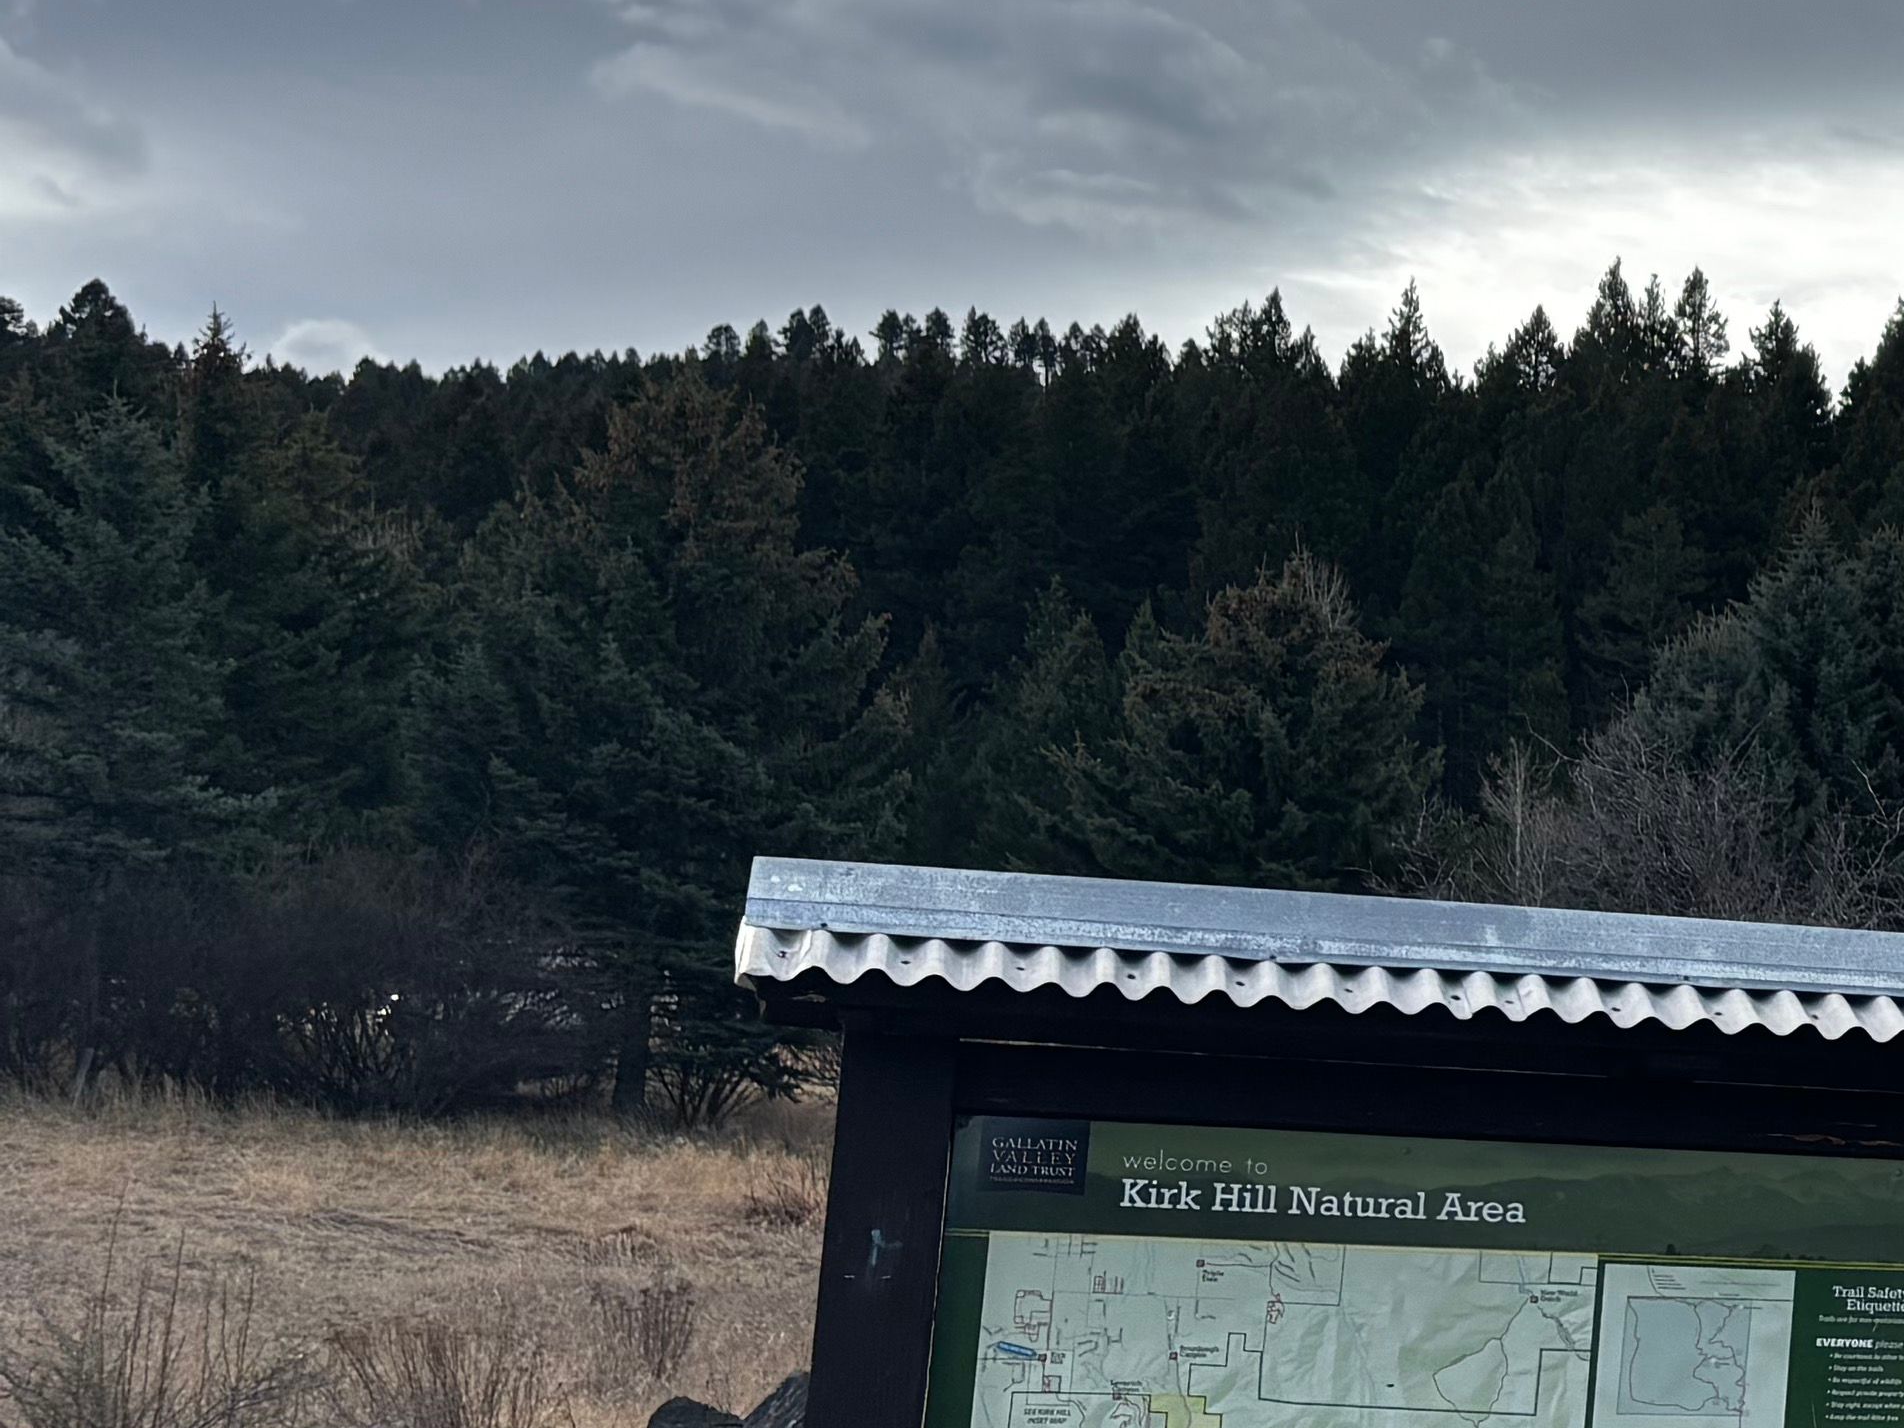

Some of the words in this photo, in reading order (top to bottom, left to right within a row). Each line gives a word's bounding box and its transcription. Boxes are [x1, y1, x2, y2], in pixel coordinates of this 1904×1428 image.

[992, 1137, 1077, 1151] GALLATIN
[992, 1150, 1075, 1164] VALLEY
[1123, 1150, 1232, 1173] welcome
[1247, 1158, 1267, 1175] to
[990, 1163, 1027, 1175] LAND
[1033, 1166, 1075, 1177] TRUST
[1120, 1179, 1201, 1210] Kirk
[1211, 1182, 1276, 1213] Hill
[1288, 1186, 1426, 1219] Natural
[1436, 1192, 1526, 1223] Area
[1832, 1285, 1864, 1298] Trail
[1816, 1338, 1873, 1348] EVERYONE
